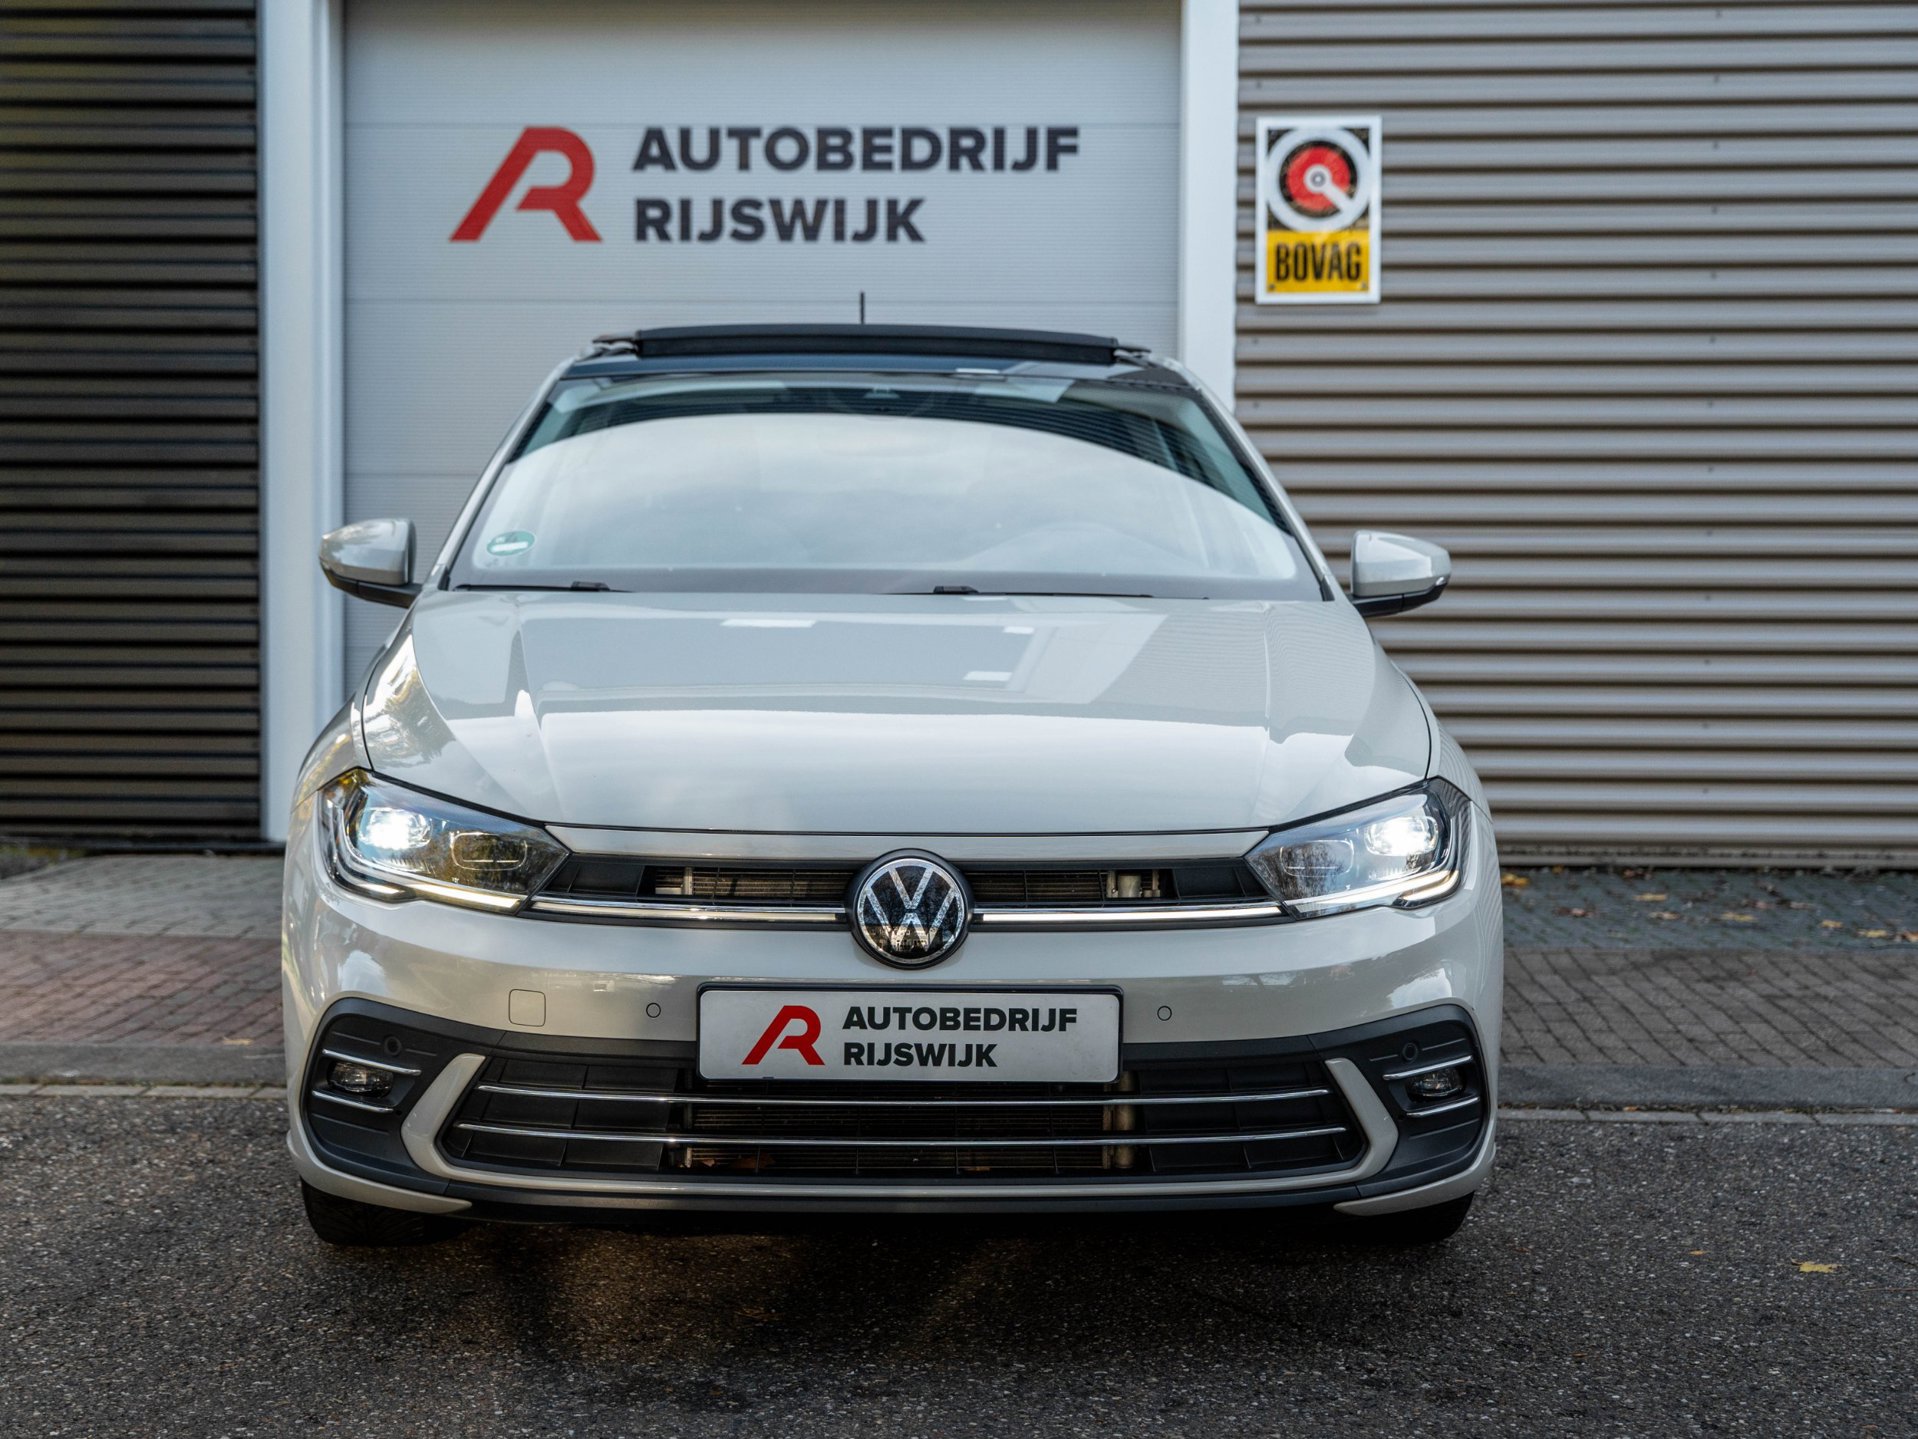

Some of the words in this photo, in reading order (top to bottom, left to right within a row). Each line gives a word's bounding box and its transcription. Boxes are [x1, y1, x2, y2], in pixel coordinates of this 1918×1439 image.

[632, 126, 1080, 172] AUTOBEDRIJF
[634, 197, 926, 242] RIJSWIJK
[1275, 242, 1361, 282] BOVAG
[842, 1006, 1077, 1031] AUTOBEDRIJF
[843, 1042, 998, 1068] RIJSWIJK
